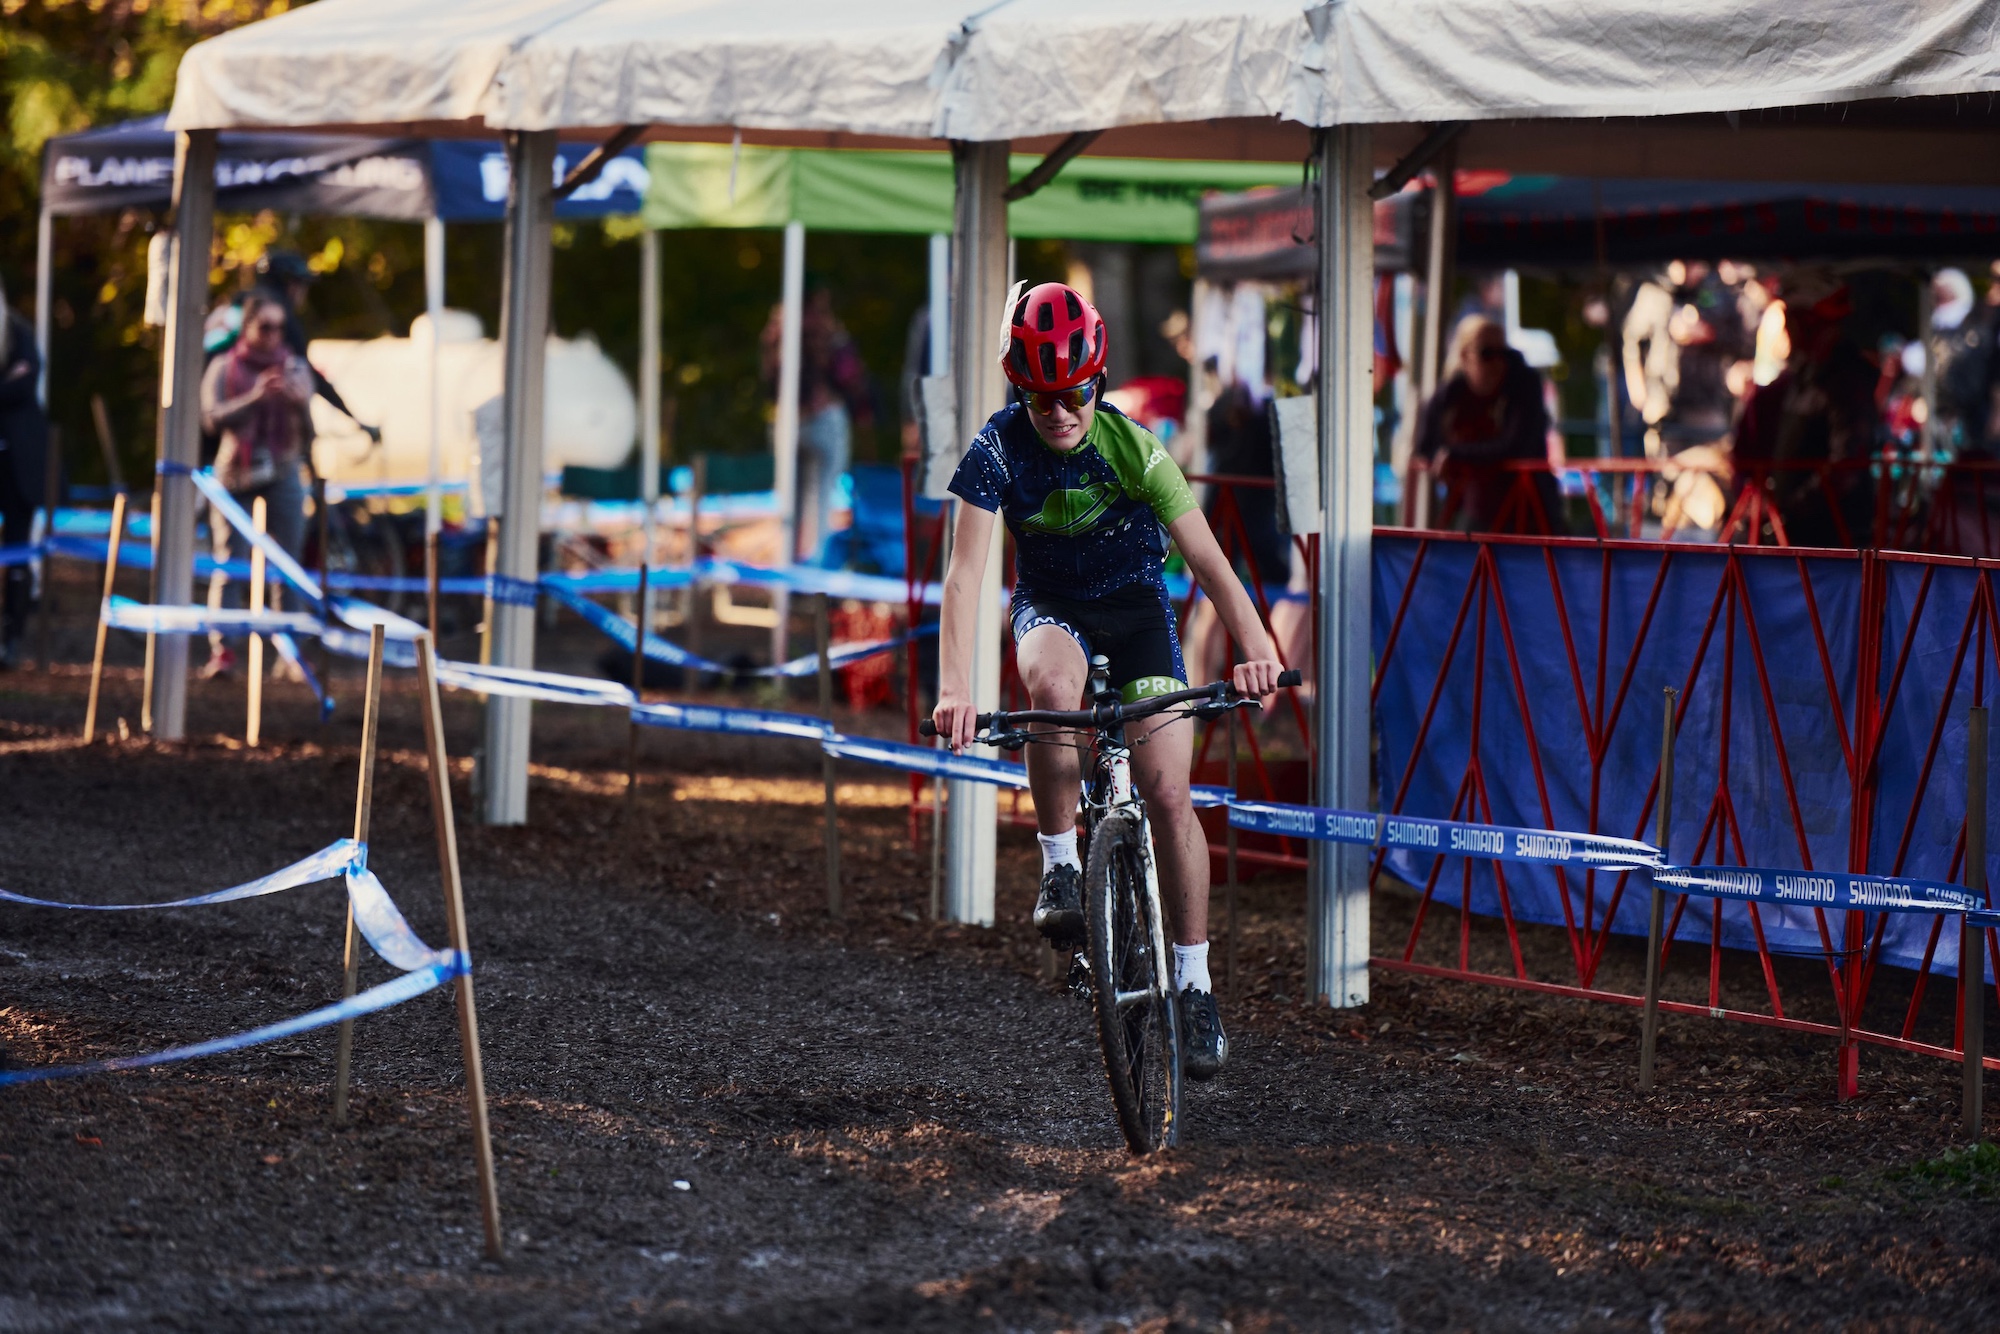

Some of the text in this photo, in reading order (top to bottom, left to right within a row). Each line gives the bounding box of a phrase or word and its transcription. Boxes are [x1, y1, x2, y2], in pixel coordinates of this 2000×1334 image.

[1267, 810, 1315, 833] SHIMANO
[1326, 814, 1376, 840] SHIMANO
[1387, 821, 1439, 847] SHIMANO
[1450, 828, 1504, 854] SHIMANO
[1516, 834, 1572, 861] SHIMANO
[1703, 870, 1762, 896] SHIMANO
[1775, 875, 1836, 902] SHIMANO
[1849, 881, 1912, 908] SHIMANO
